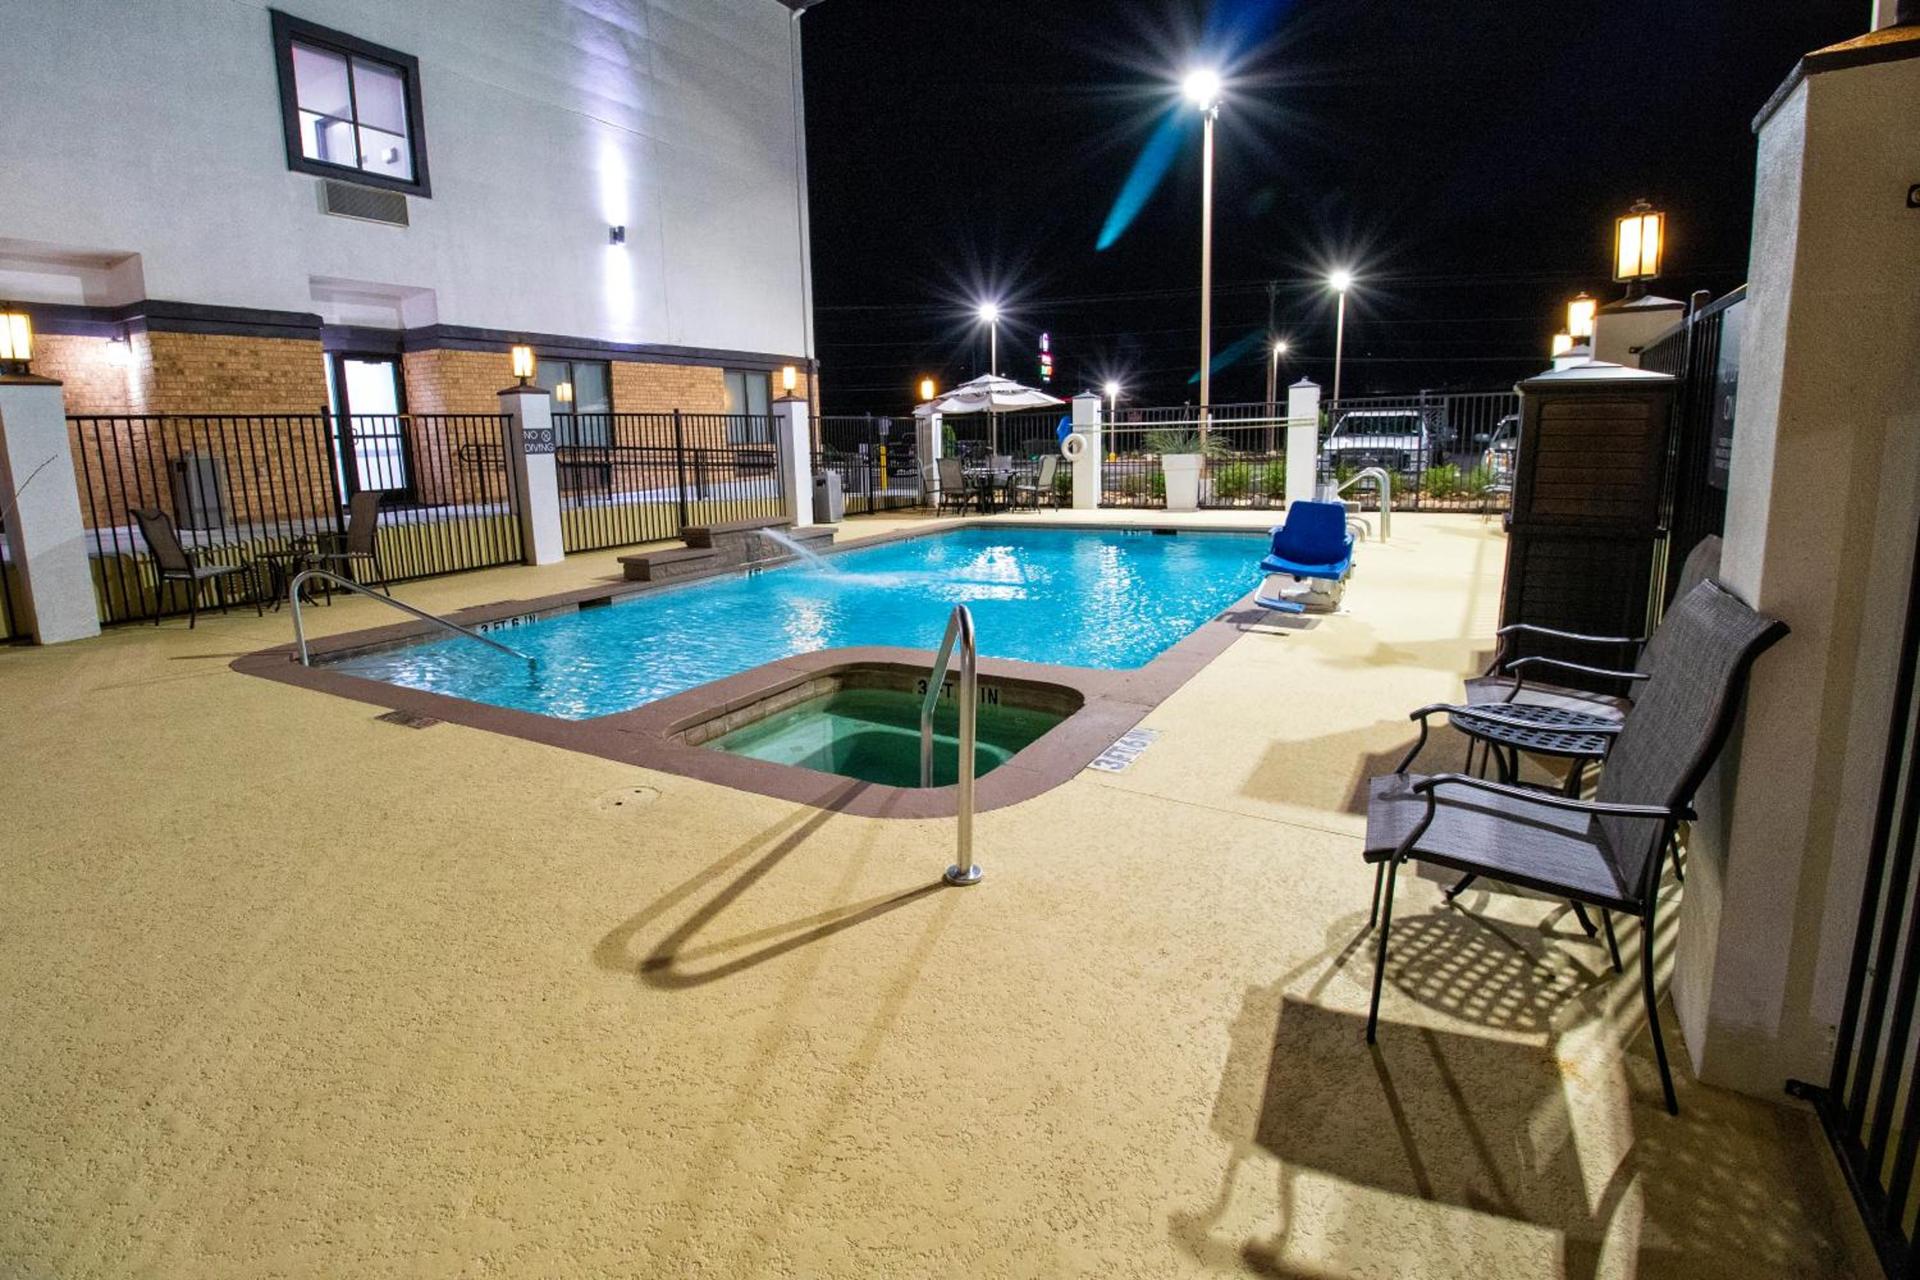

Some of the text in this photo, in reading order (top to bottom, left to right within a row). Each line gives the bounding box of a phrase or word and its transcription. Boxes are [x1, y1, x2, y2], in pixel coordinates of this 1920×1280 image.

[523, 430, 538, 440] NO
[524, 442, 555, 453] DIVING
[494, 620, 506, 631] FT
[524, 613, 536, 624] IN
[918, 679, 927, 695] 3
[981, 687, 998, 705] IN
